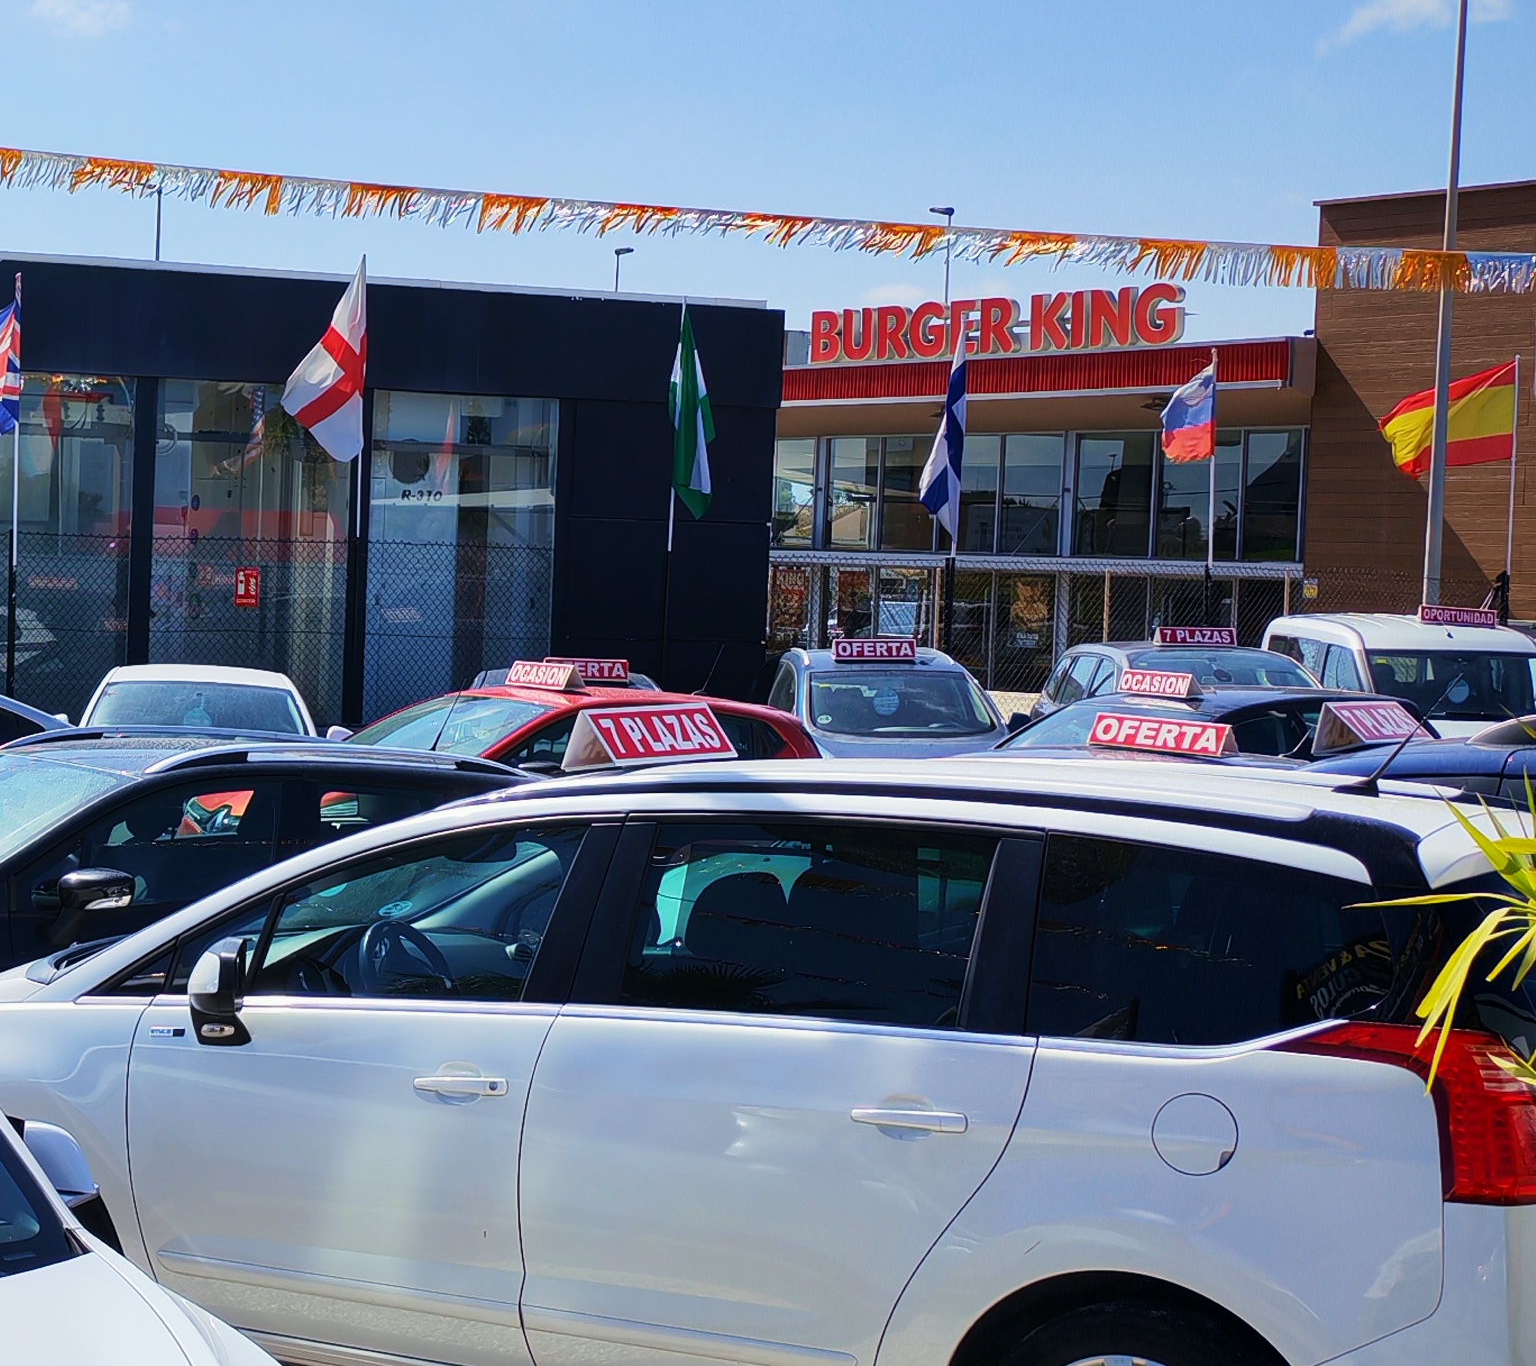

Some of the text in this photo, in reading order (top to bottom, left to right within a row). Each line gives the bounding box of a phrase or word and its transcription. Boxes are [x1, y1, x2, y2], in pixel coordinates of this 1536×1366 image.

[810, 283, 1186, 363] BURGER KING
[1423, 608, 1494, 625] OPORTUNIDAD
[1163, 630, 1231, 644] 7 PLAZAS
[838, 642, 912, 658] OFERTA
[510, 664, 569, 686] OCASION
[571, 661, 626, 677] ERTA
[1121, 674, 1190, 695] OCASION
[598, 713, 722, 754] 7 PLAZAS
[1095, 718, 1217, 752] OFERTA
